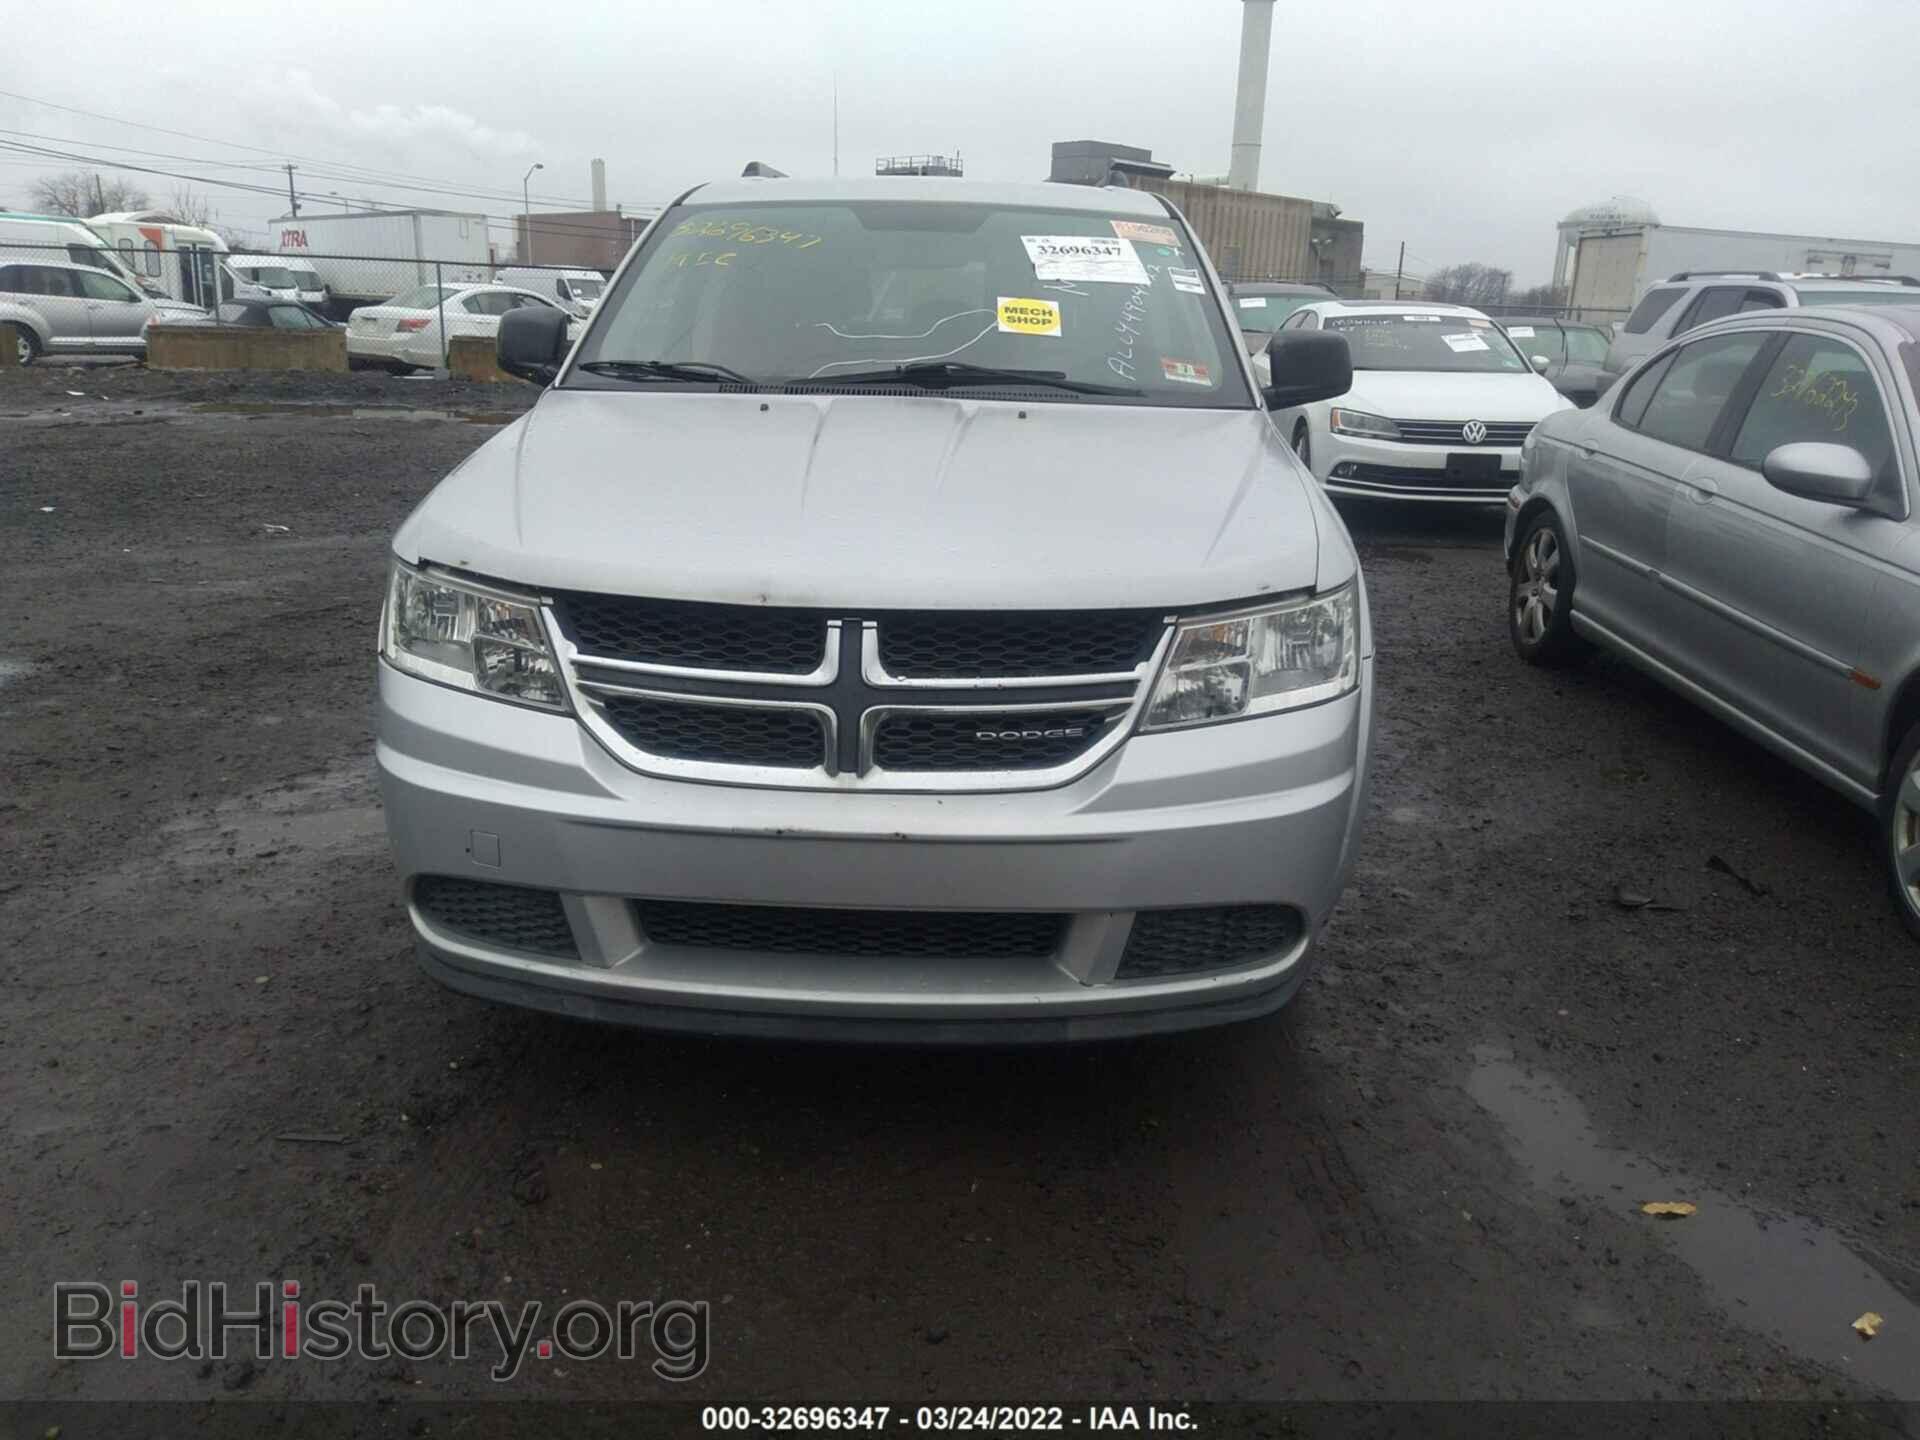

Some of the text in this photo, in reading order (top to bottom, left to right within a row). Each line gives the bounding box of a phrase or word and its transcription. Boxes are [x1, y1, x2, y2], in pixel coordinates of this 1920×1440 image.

[281, 229, 309, 248] XTRA
[1038, 244, 1122, 257] 32696347
[1004, 306, 1053, 317] MECH
[1006, 315, 1053, 326] SHOP
[1462, 420, 1487, 444] VW
[976, 727, 1084, 740] DODGE
